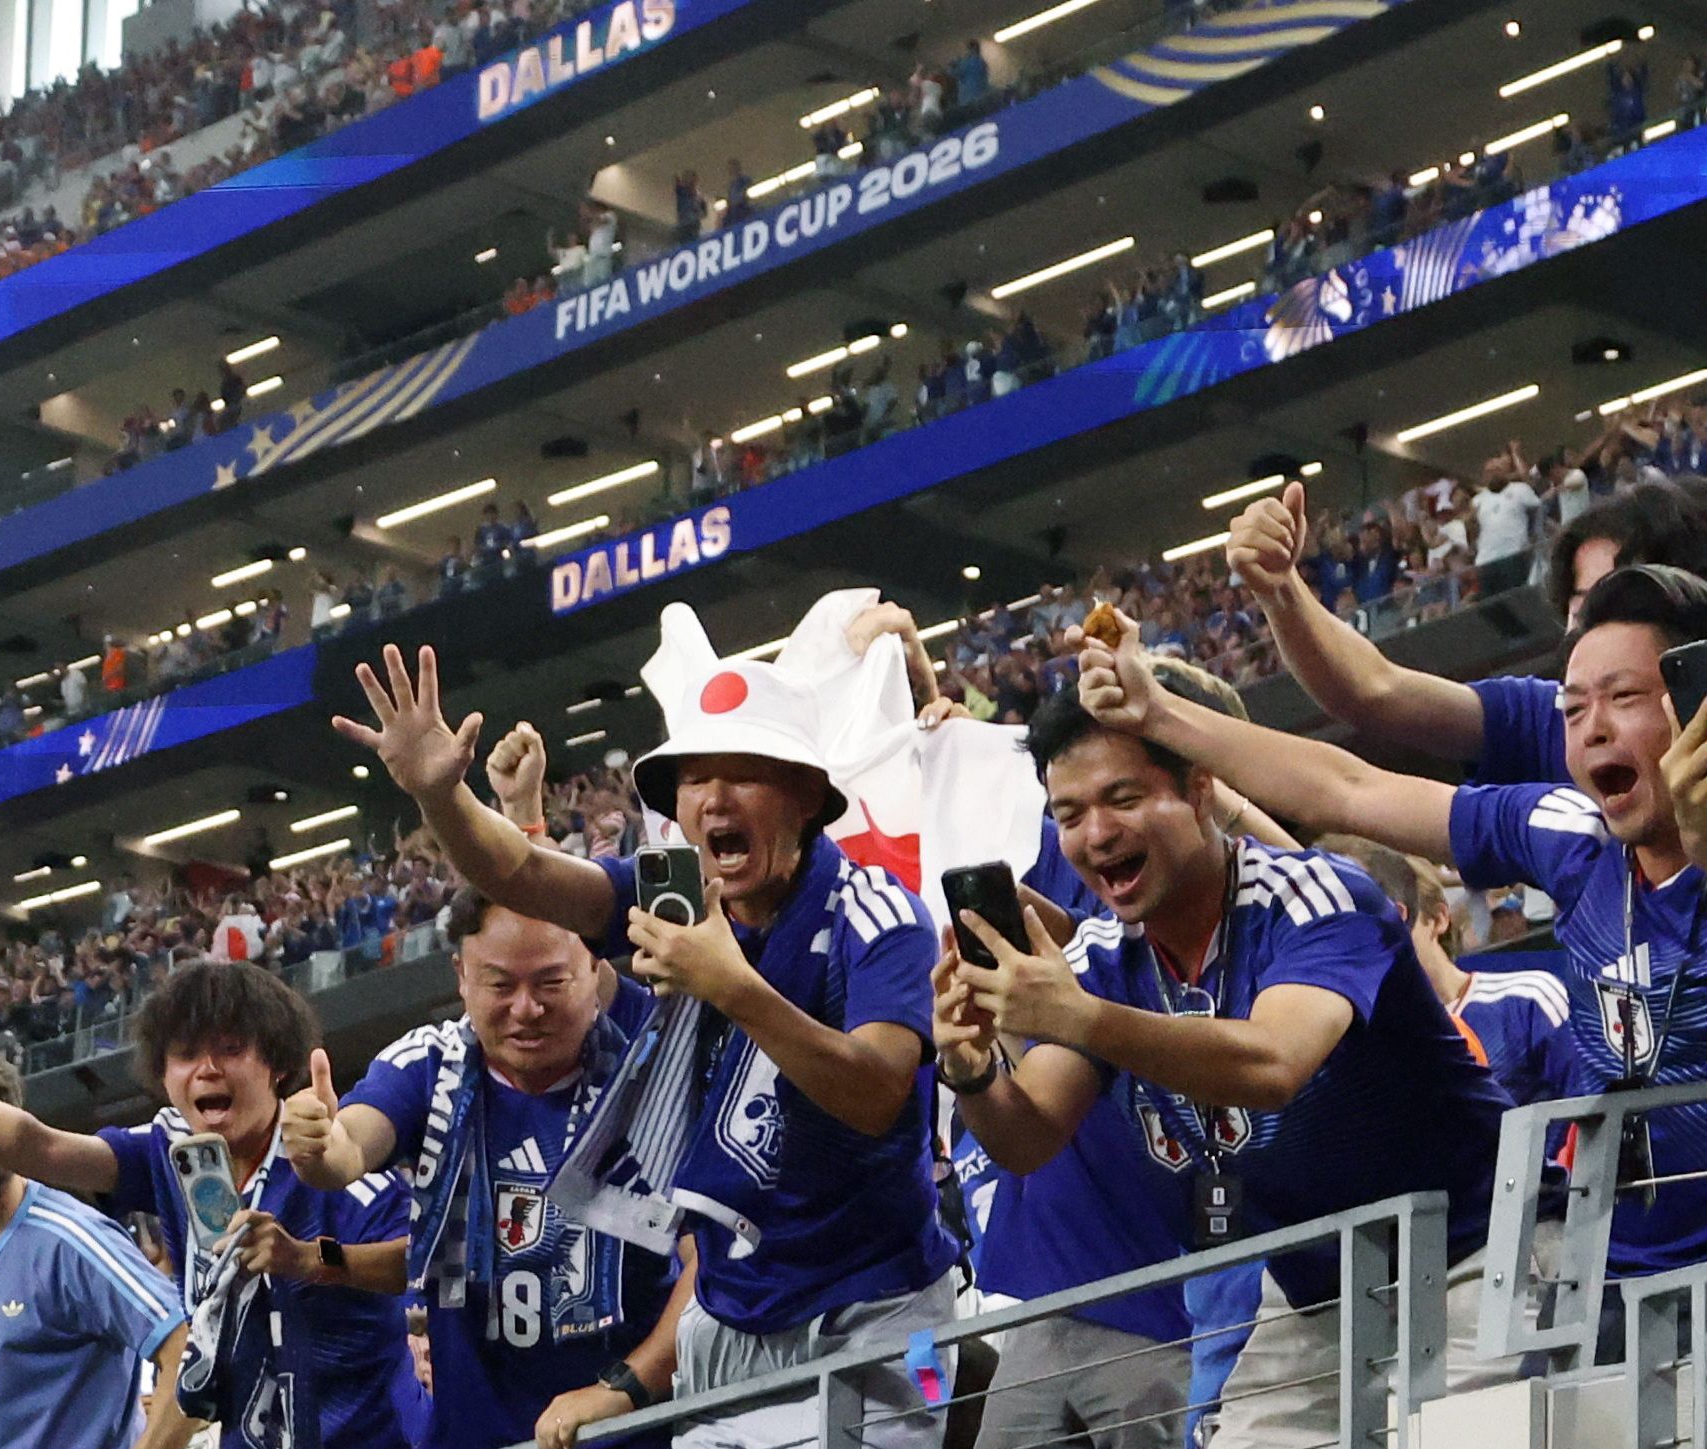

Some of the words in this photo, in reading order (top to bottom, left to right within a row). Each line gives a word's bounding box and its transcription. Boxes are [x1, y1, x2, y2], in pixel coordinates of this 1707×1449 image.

[478, 0, 676, 121] DALLAS
[553, 277, 631, 340] FIFA
[635, 220, 770, 305] WORLD
[774, 180, 852, 248] CUP
[856, 121, 1000, 215] 2026
[551, 505, 732, 613] DALLAS
